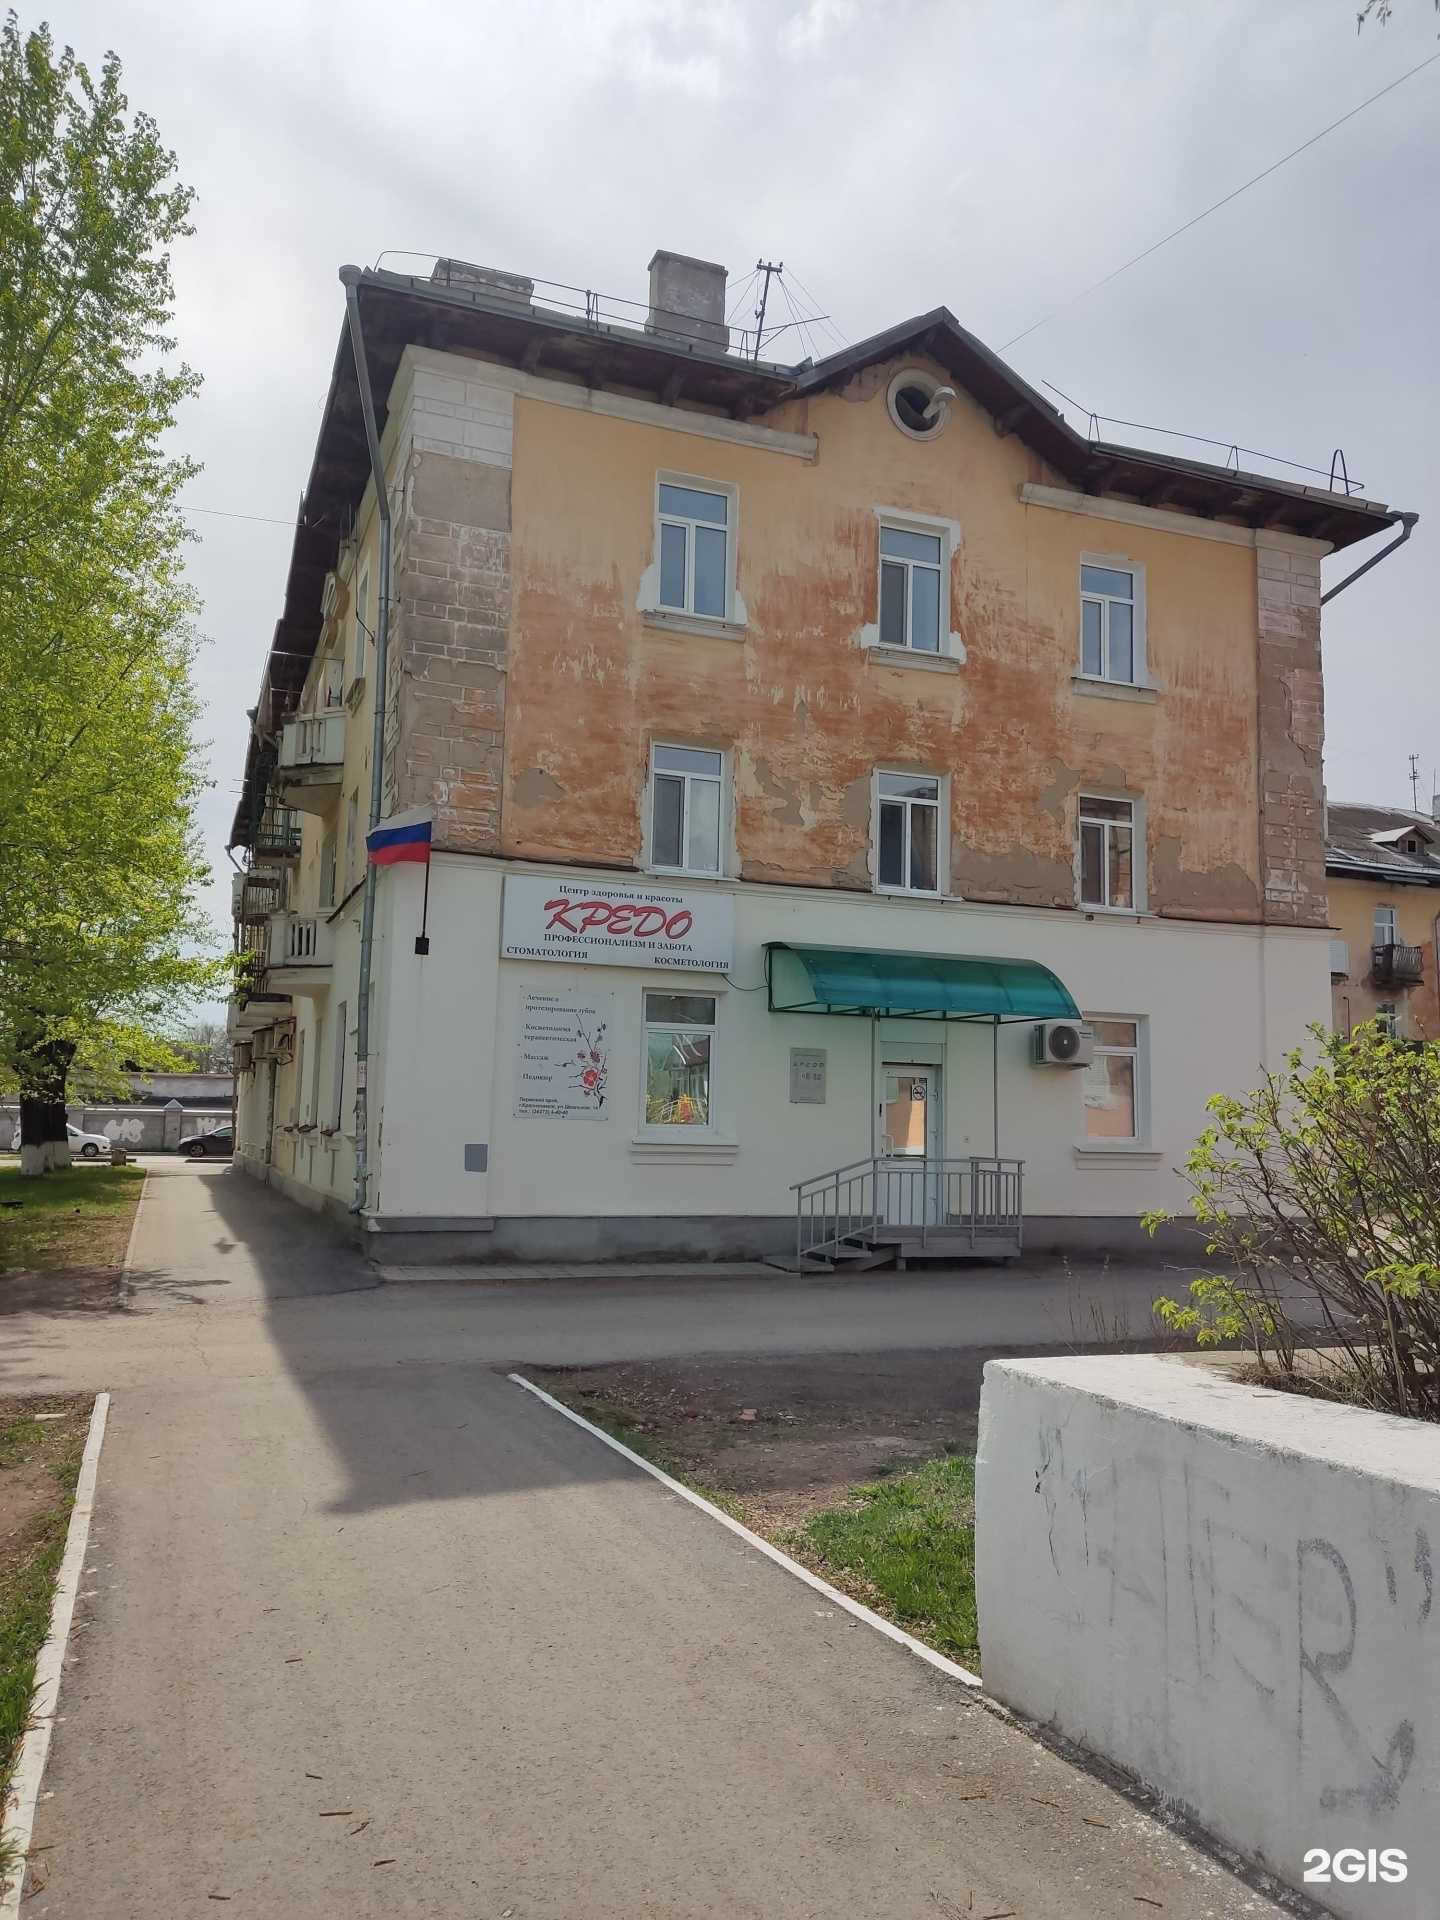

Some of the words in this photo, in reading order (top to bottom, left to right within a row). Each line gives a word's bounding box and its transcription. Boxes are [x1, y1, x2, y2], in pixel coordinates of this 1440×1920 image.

[559, 885, 589, 896] Центр
[591, 889, 634, 900] здоровья
[645, 895, 683, 904] красоты
[543, 933, 647, 949] ПРОФЕССИОНАЛИЗМ
[648, 941, 655, 949] И
[657, 942, 693, 952] ЗАБОТА
[506, 946, 588, 959] СТОМАТОЛОГИЯ
[654, 956, 729, 969] КОСМЕТОЛОГИЯ
